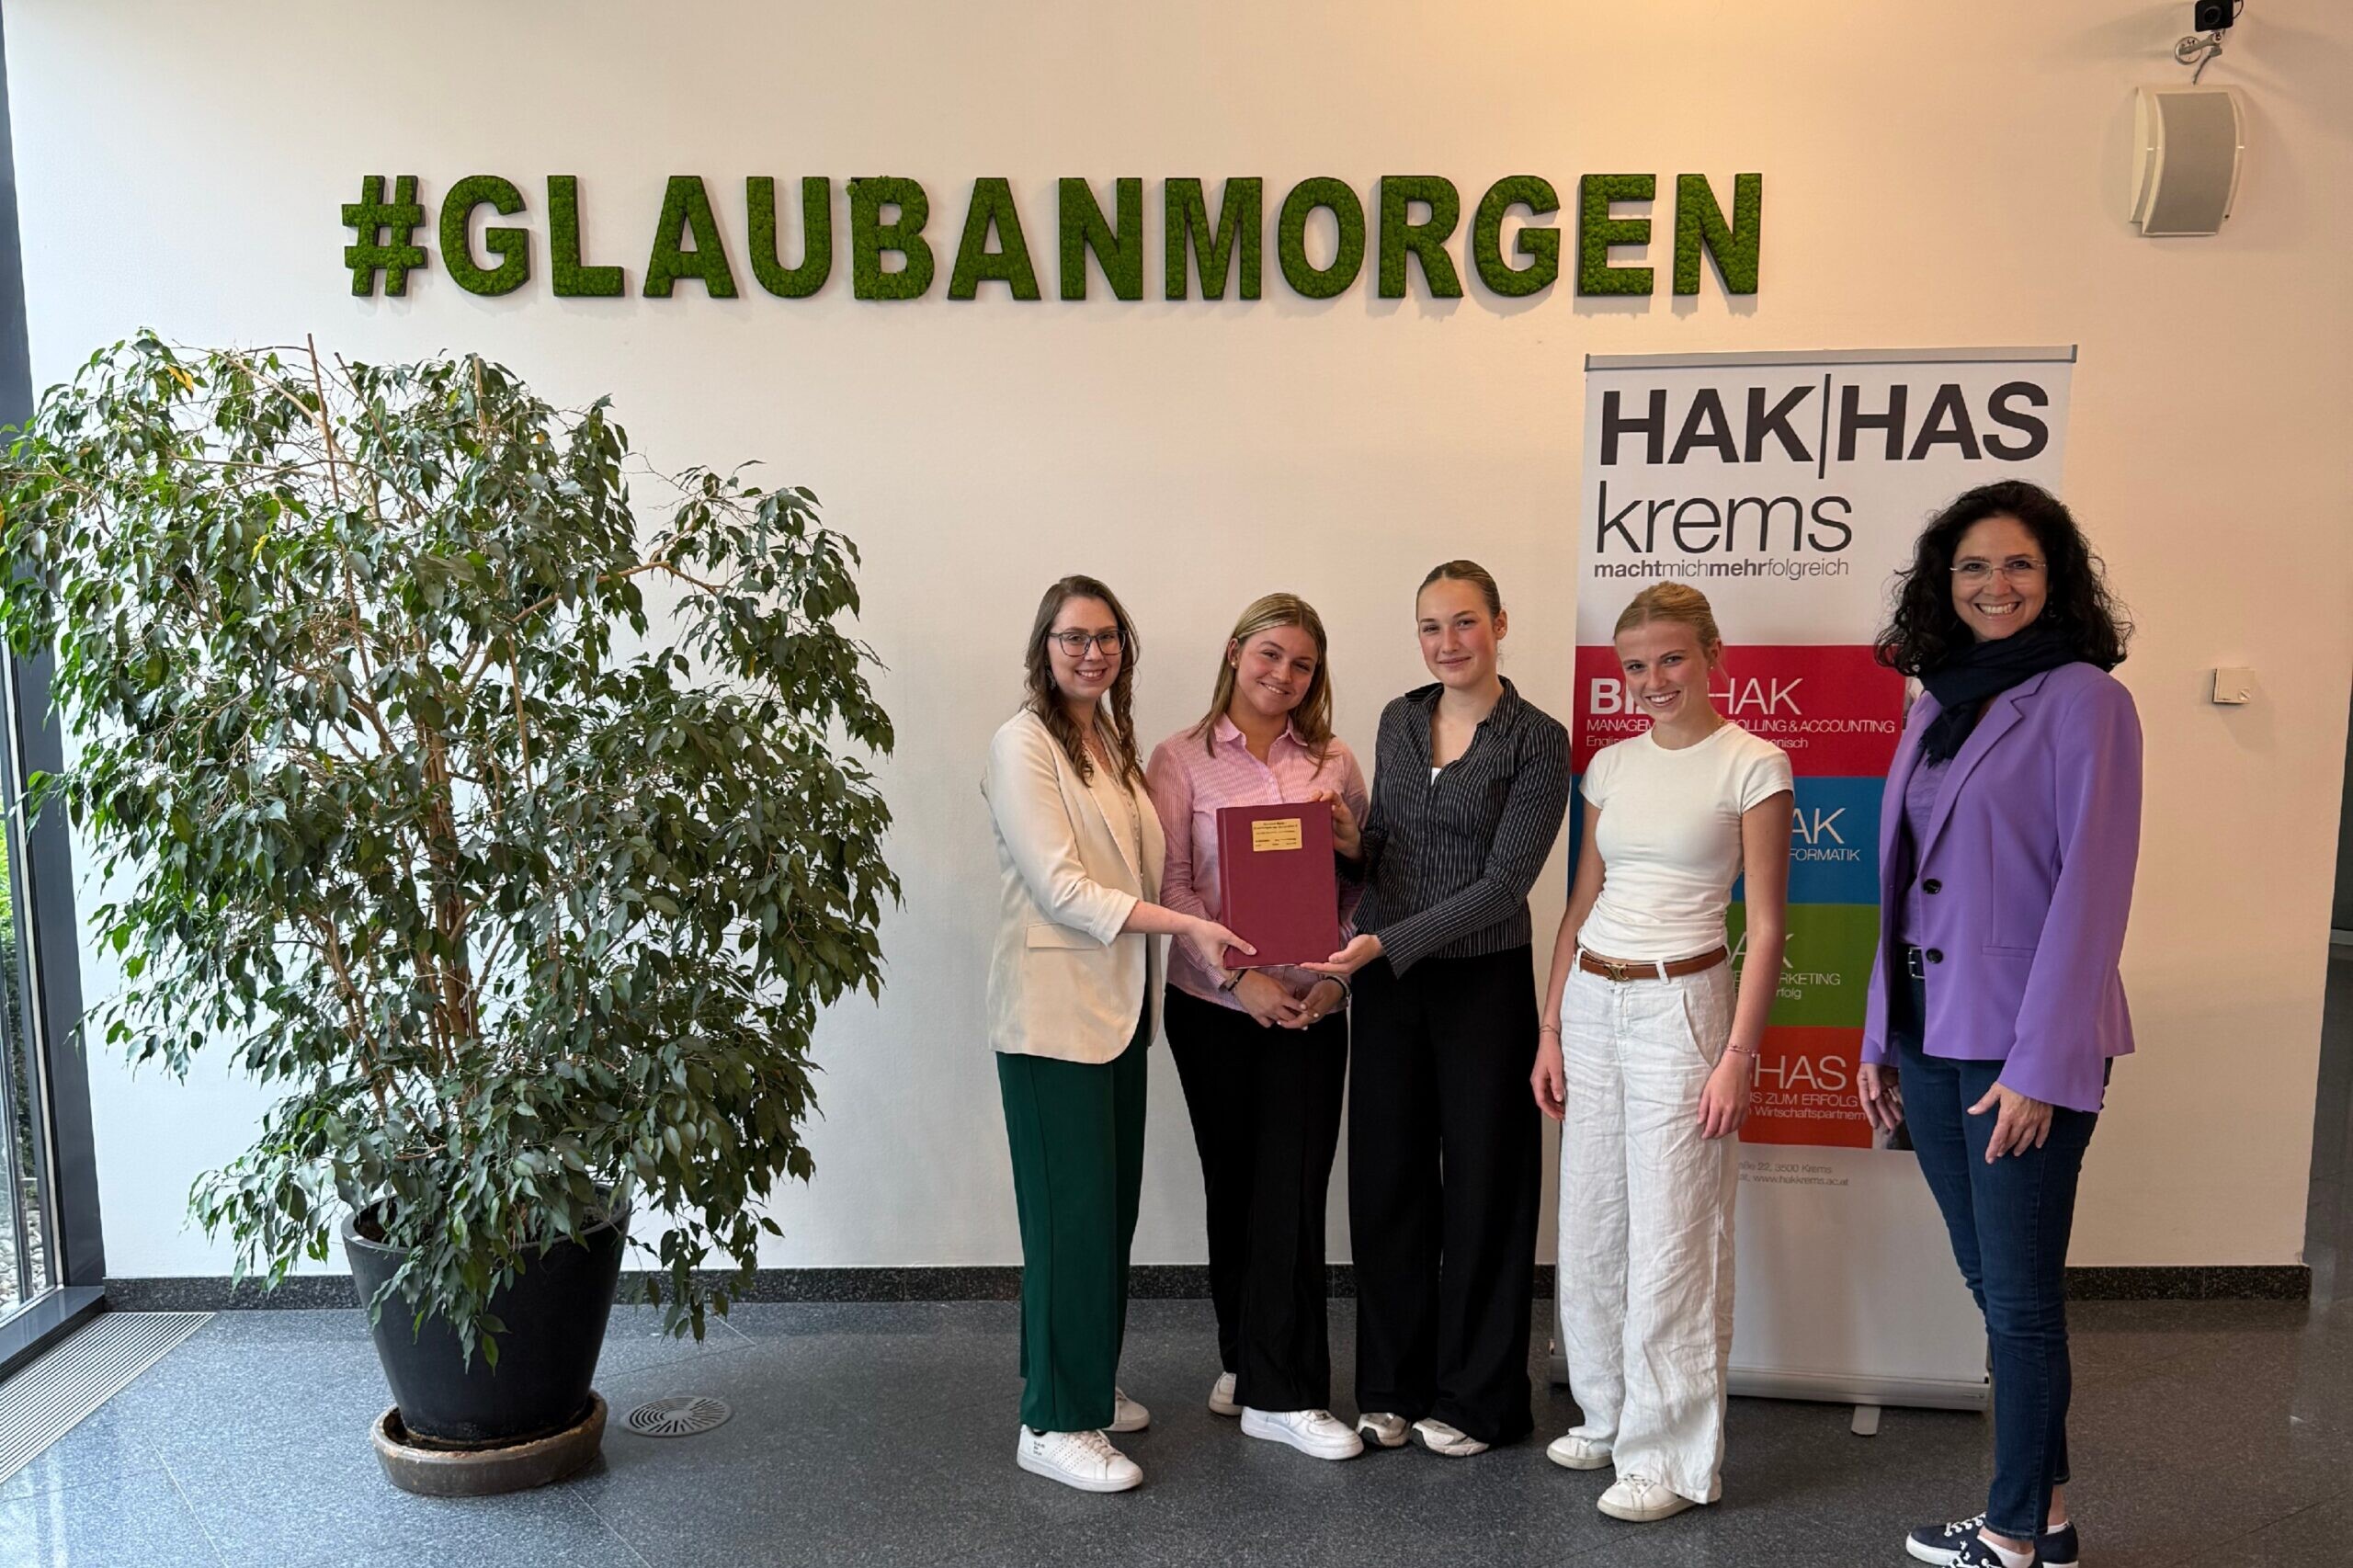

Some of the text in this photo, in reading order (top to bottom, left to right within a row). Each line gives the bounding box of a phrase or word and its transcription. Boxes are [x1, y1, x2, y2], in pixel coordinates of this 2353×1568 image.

[341, 173, 1762, 301] #GLAUBANMORGEN
[1597, 480, 1852, 554] krems
[1594, 558, 1848, 581] machtmichmehrfolgreich
[1590, 677, 1649, 714] BI
[1586, 719, 1654, 732] MANAGEM
[1727, 719, 1787, 733] OLLING
[1799, 720, 1895, 733] ACCOUNTING
[1792, 808, 1846, 844] AK
[1789, 847, 1860, 861] FORMATIK
[1779, 972, 1841, 985] RKETING
[1776, 987, 1802, 1000] rfolg
[1754, 1054, 1847, 1091] HAS
[1765, 1092, 1798, 1105] ZUM
[1802, 1094, 1859, 1108] ERFOLG
[1802, 1164, 1832, 1174] Krems
